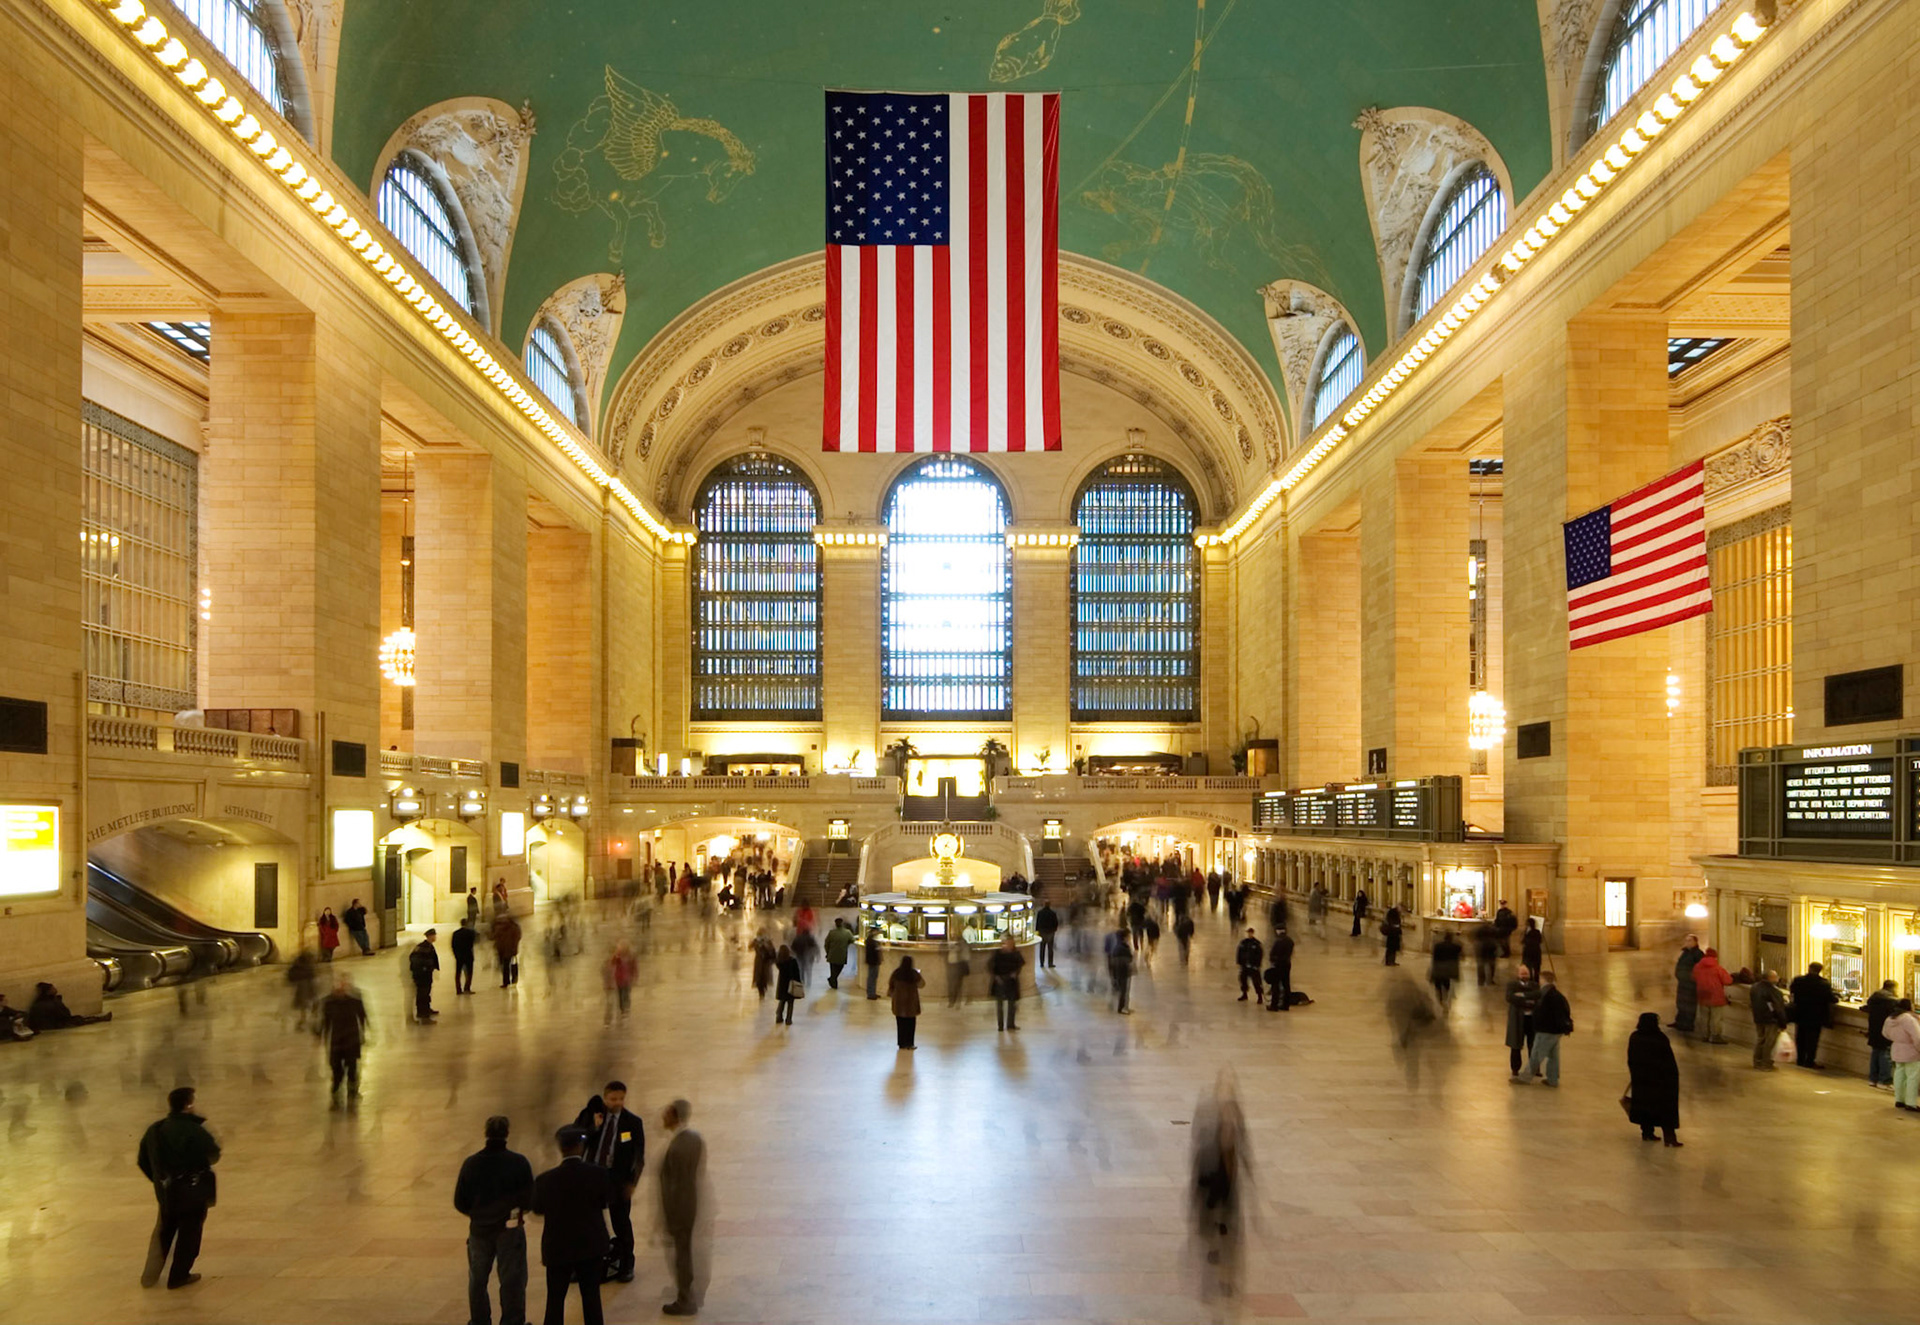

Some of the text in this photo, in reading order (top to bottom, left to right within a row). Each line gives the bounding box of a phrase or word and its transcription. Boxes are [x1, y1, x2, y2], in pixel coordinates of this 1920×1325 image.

[1803, 744, 1872, 758] INFORMATION
[1805, 767, 1835, 775] ATTENTION
[1787, 779, 1803, 787] NEVER
[1805, 778, 1822, 786] LEAVE
[1824, 777, 1851, 785] PACKAGES
[1786, 790, 1819, 798] UNATTENDED
[1820, 789, 1838, 797] ITEMS
[1853, 788, 1862, 796] BE
[1864, 787, 1891, 796] REMOVED
[1823, 800, 1845, 808] POLICE
[244, 808, 273, 824] STREET
[87, 803, 196, 842] THE METLIFE BUILDING
